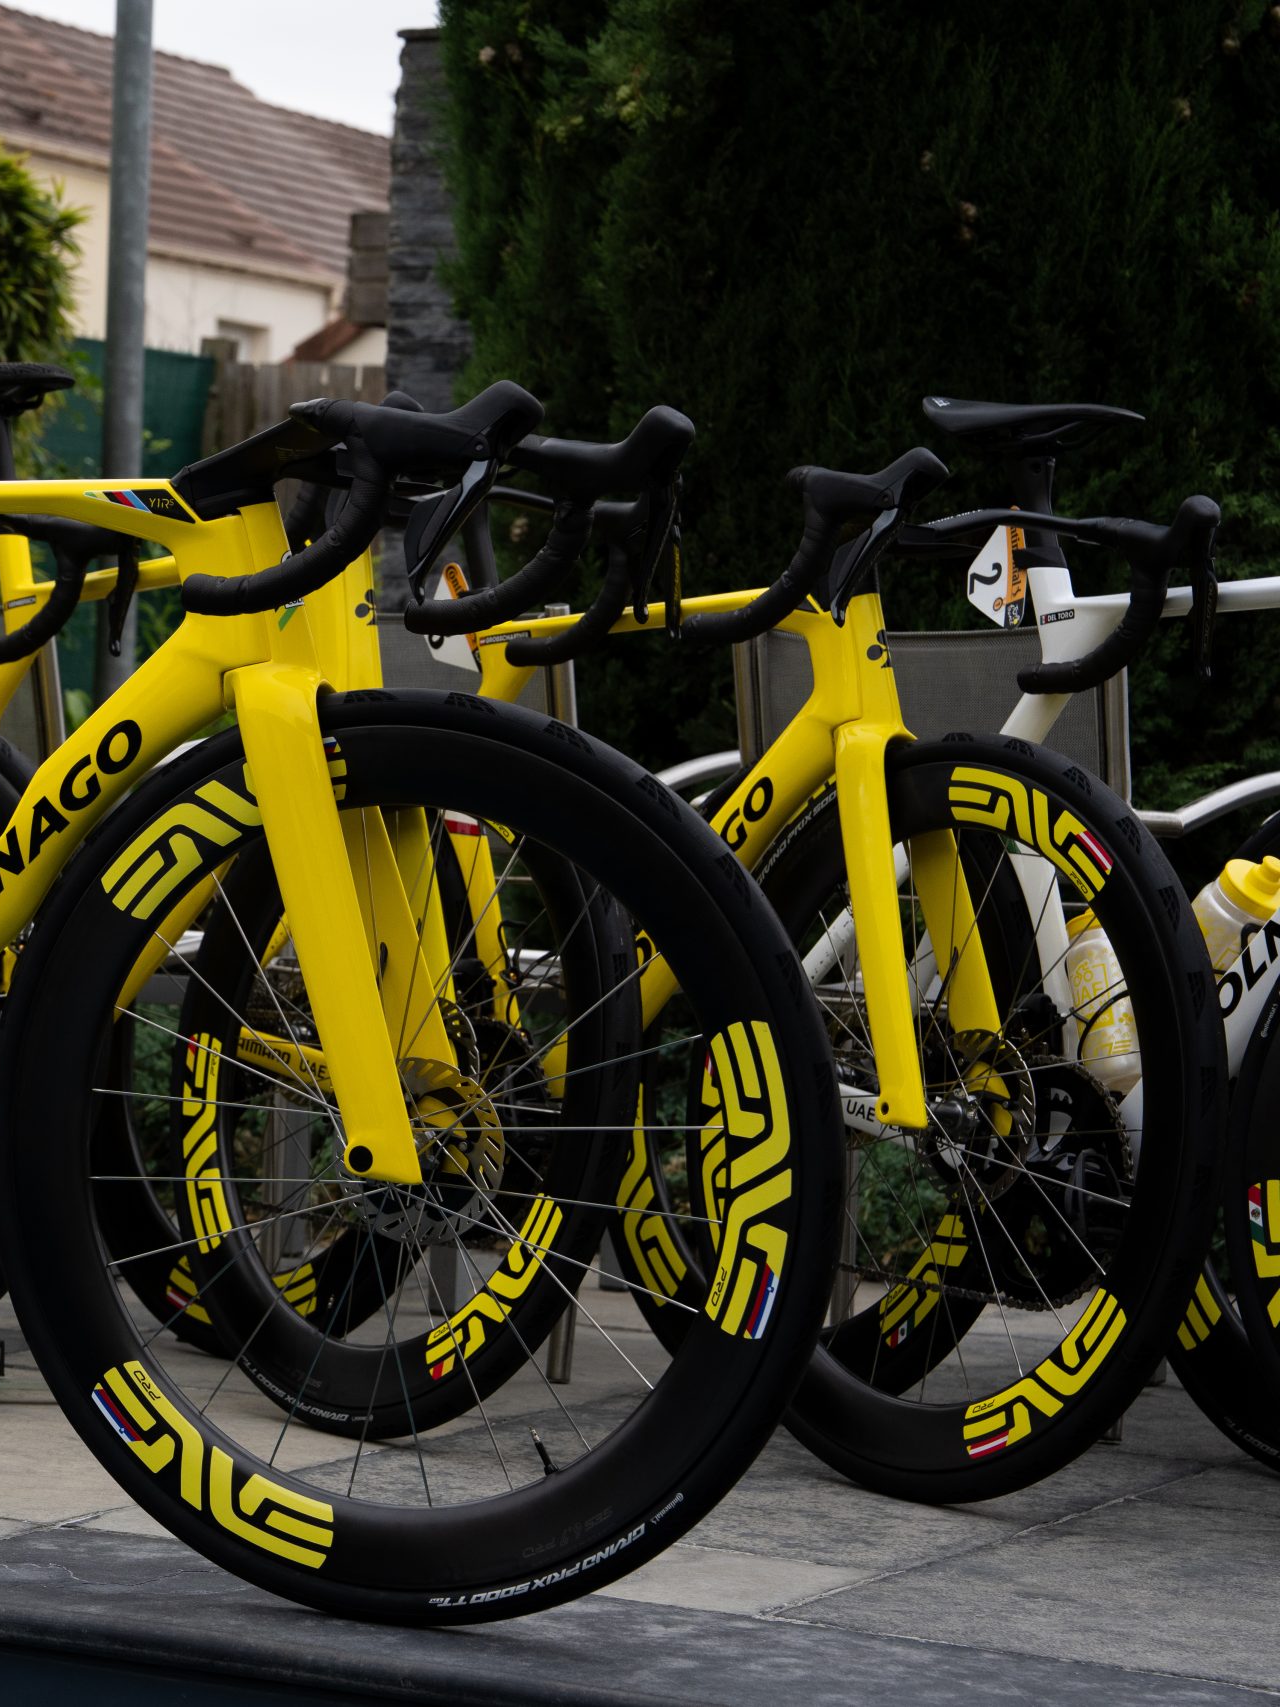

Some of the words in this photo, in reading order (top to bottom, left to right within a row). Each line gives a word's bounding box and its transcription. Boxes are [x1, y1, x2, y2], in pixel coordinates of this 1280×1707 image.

[969, 562, 1002, 595] 2
[133, 1370, 161, 1400] PRO
[581, 1522, 646, 1571] GRAND
[531, 1564, 581, 1590] PRIX
[470, 1581, 532, 1604] 5000
